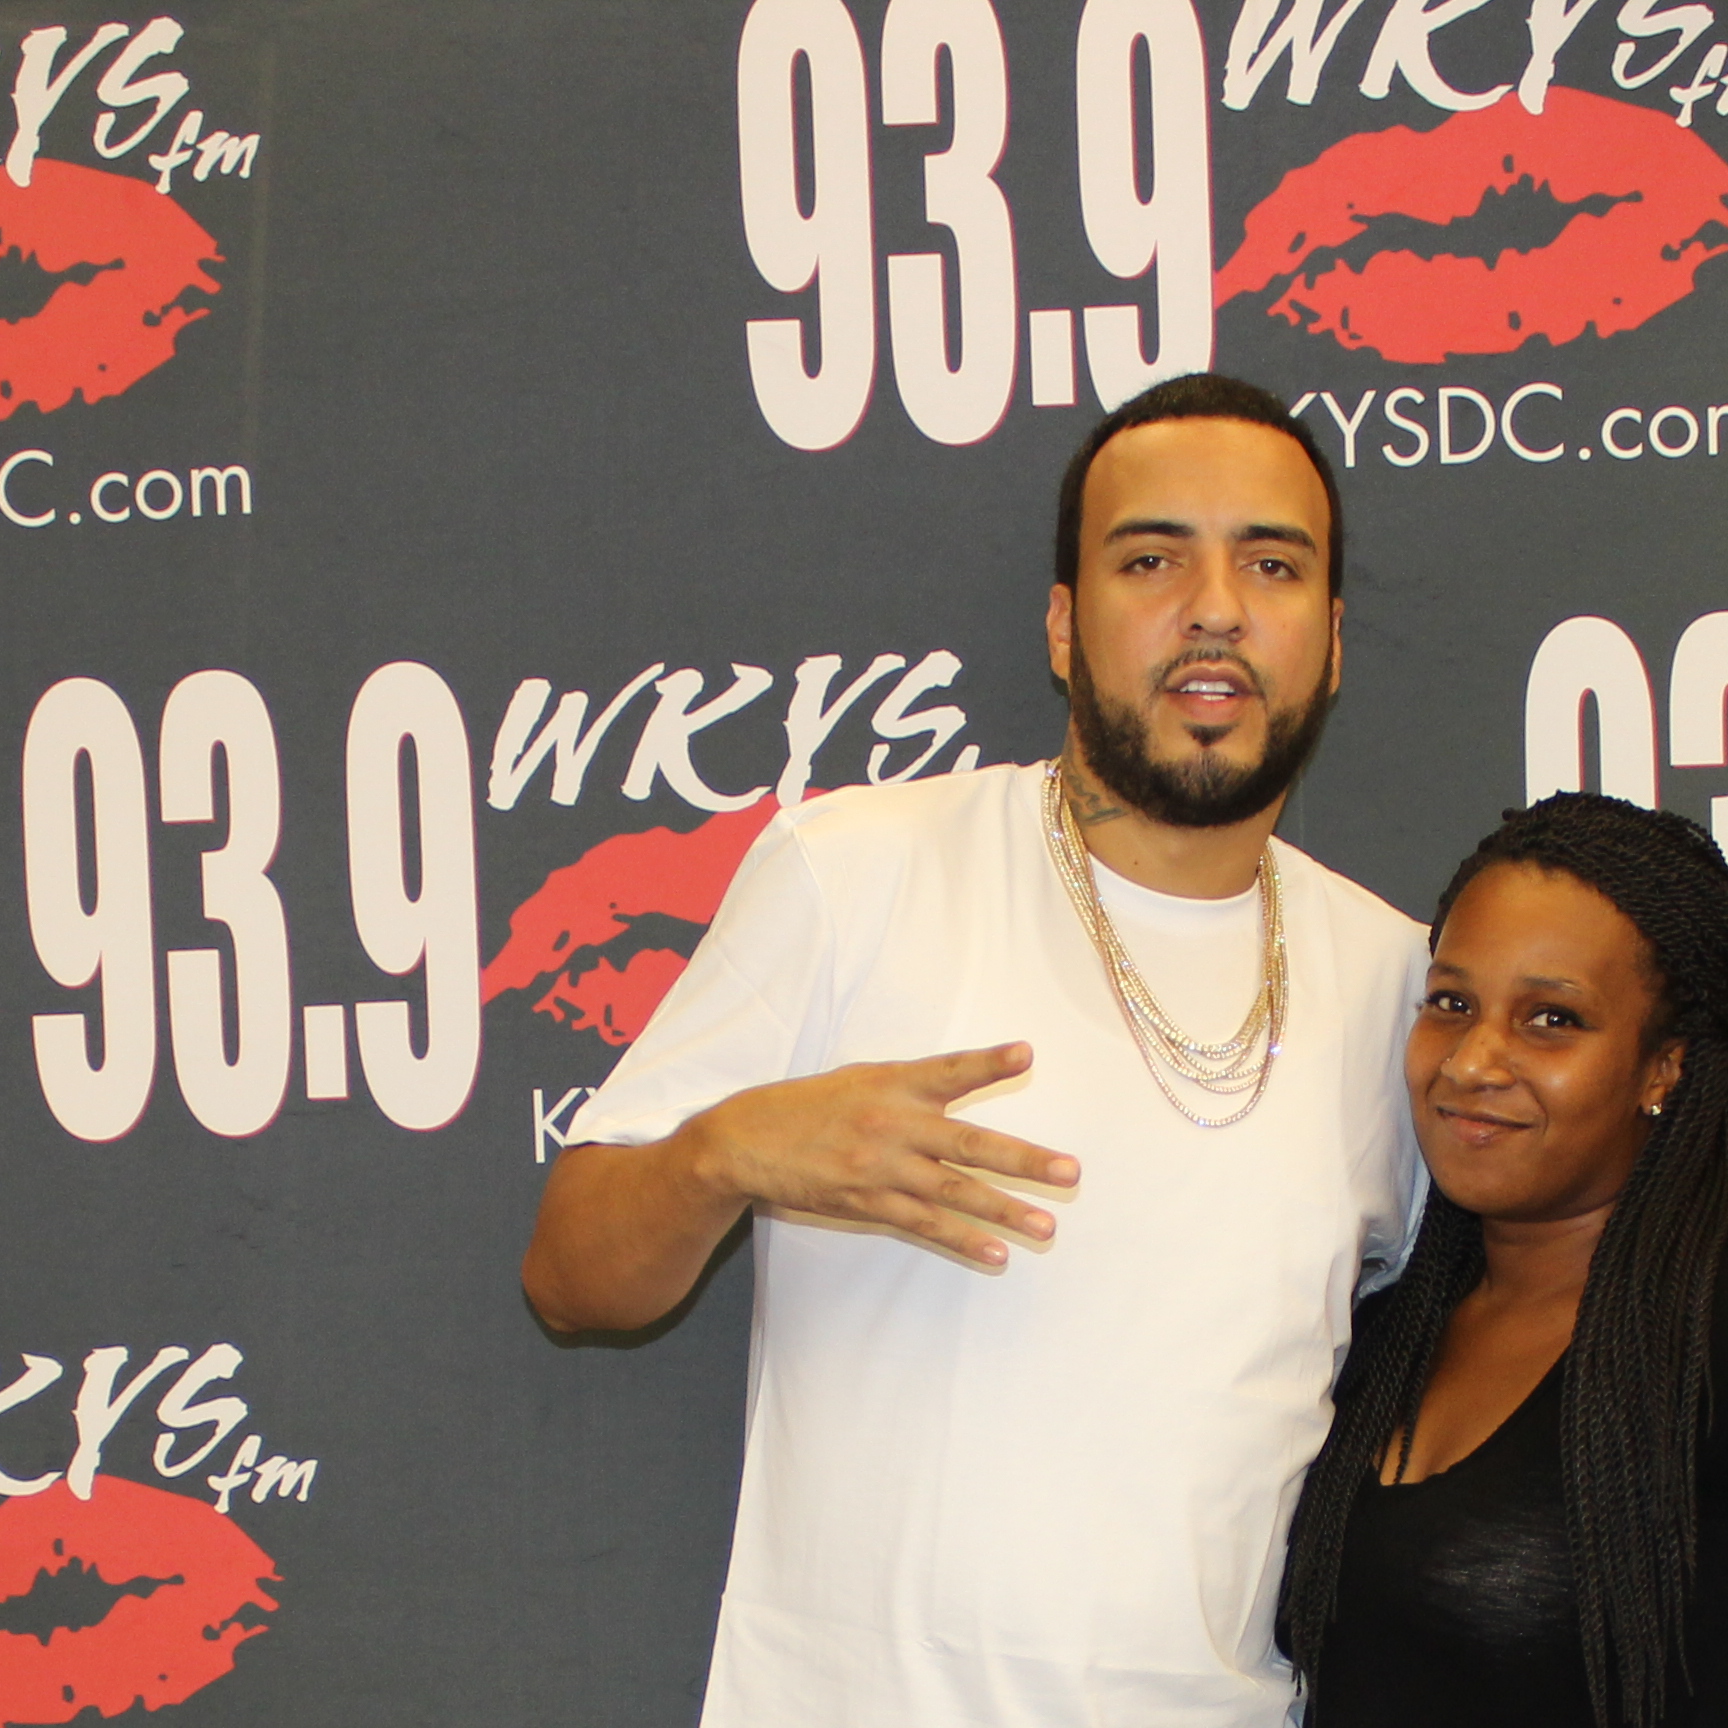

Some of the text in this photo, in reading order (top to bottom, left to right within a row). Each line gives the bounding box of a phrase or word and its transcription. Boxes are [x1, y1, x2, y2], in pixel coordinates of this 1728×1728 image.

[149, 111, 260, 194] fm
[738, 0, 1212, 450] 93.9
[23, 649, 967, 1142] 93.9 WKYS
[208, 1435, 317, 1513] fm
